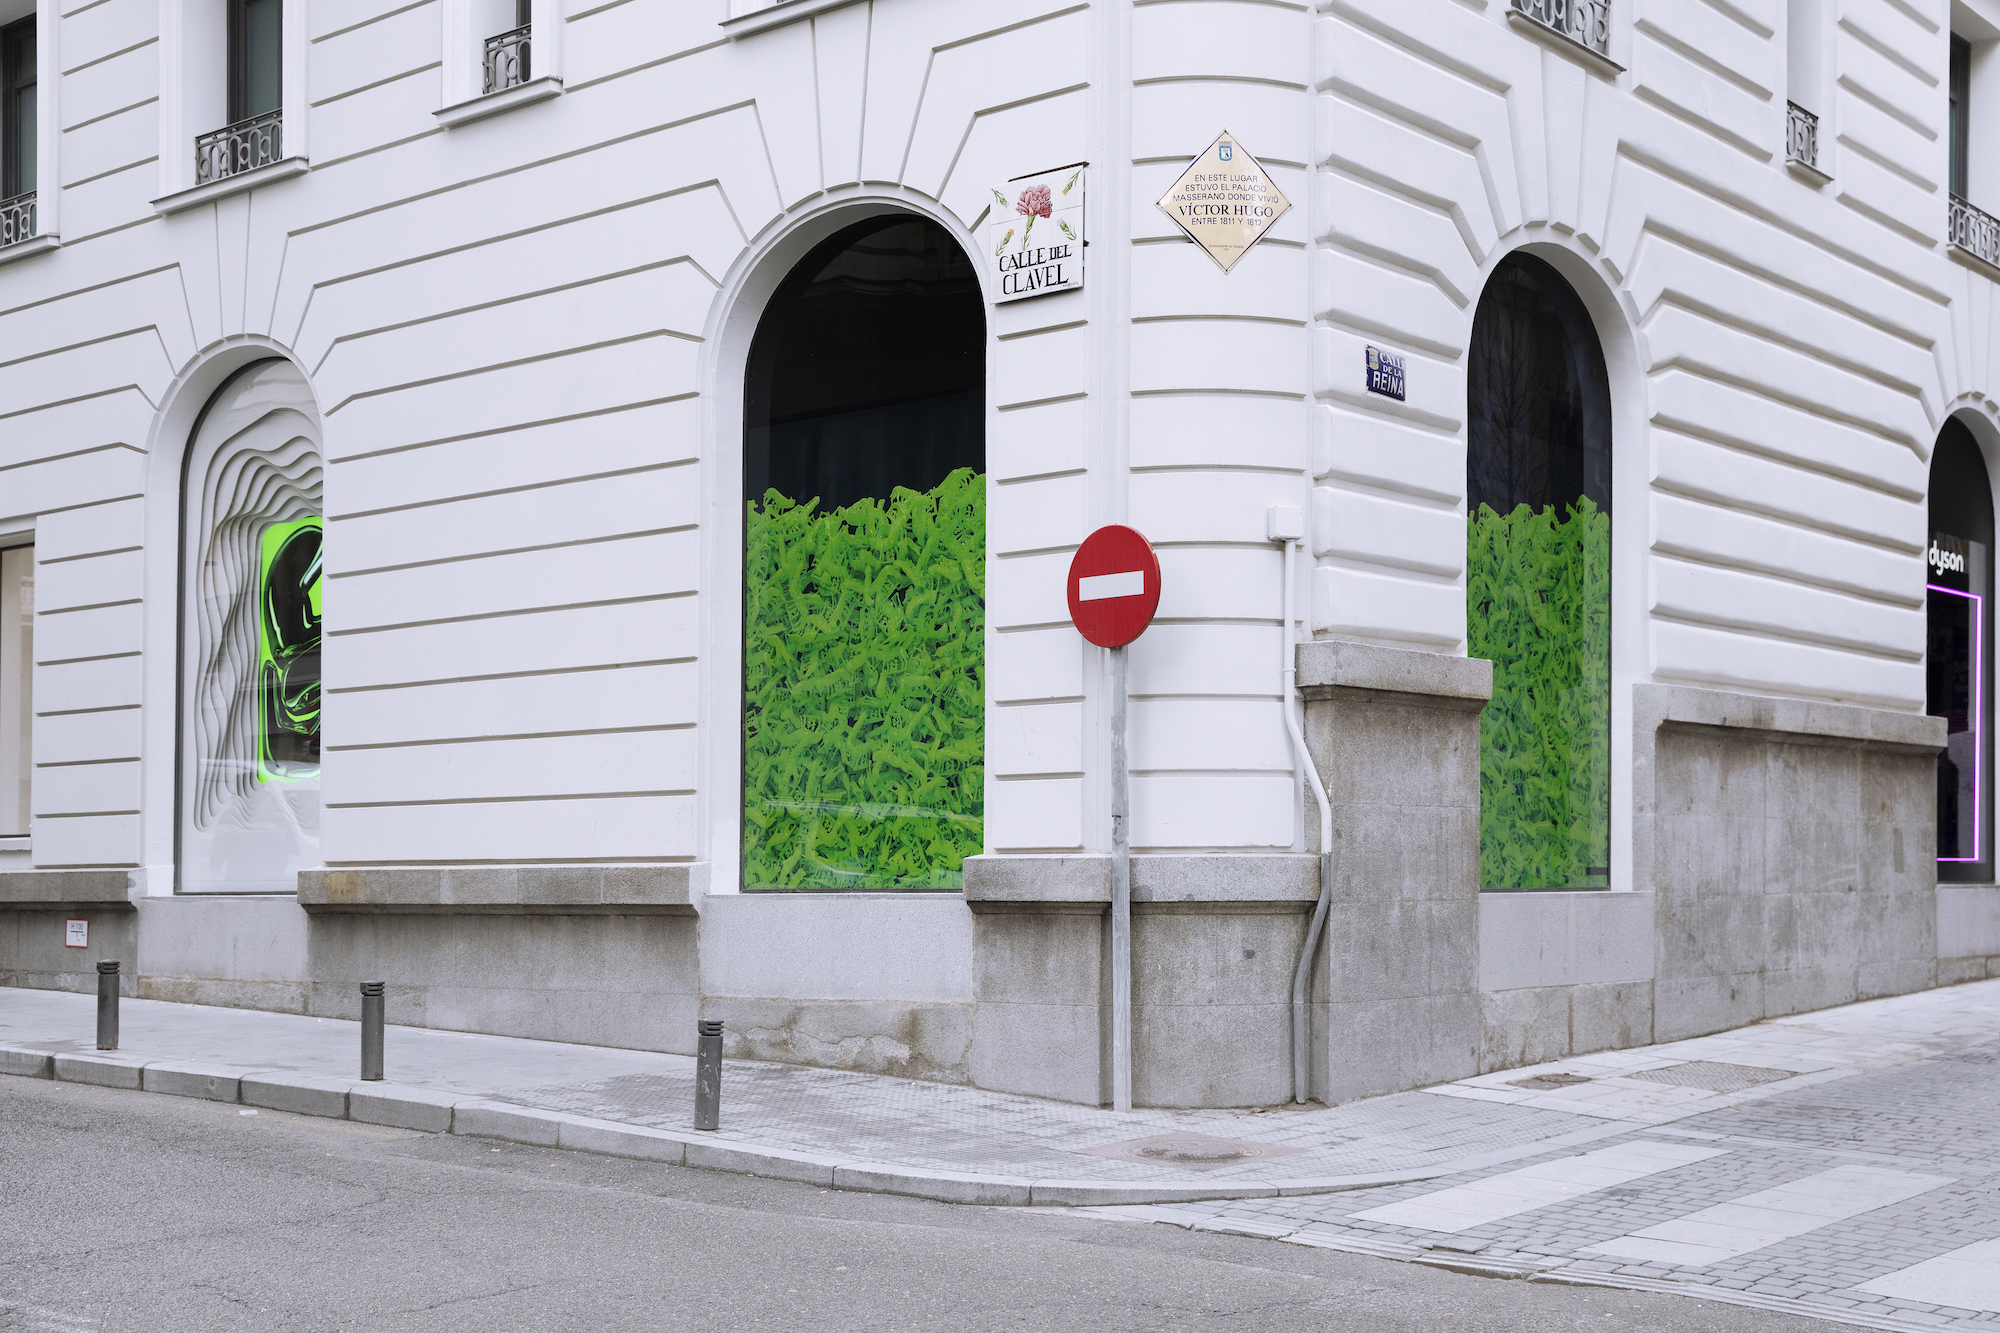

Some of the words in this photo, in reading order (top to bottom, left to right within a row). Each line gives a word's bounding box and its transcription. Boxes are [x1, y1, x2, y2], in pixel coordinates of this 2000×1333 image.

[1195, 174, 1205, 182] EN
[1208, 174, 1228, 182] ESTE
[1230, 174, 1258, 183] LUGAR
[1185, 183, 1219, 192] ESTUVO
[1220, 183, 1230, 191] EL
[1232, 184, 1267, 193] PALACIO
[1173, 193, 1225, 202] MASSERANO
[1228, 193, 1256, 201] DONDE
[1257, 194, 1279, 204] VIVIÓ
[1178, 202, 1230, 216] VÍCTOR
[1234, 205, 1274, 218] HUGO
[1191, 217, 1217, 225] ENTRE
[1220, 217, 1235, 225] 1811
[1238, 217, 1244, 225] Y
[1246, 218, 1262, 226] 1812
[999, 247, 1048, 272] CALLE
[1048, 244, 1073, 261] DEL
[1003, 263, 1070, 295] CLAVEL
[1380, 352, 1406, 371] CALLE
[1382, 364, 1393, 375] DE
[1394, 368, 1402, 378] LA
[1372, 370, 1404, 397] REINA
[1928, 540, 1964, 576] dyson
